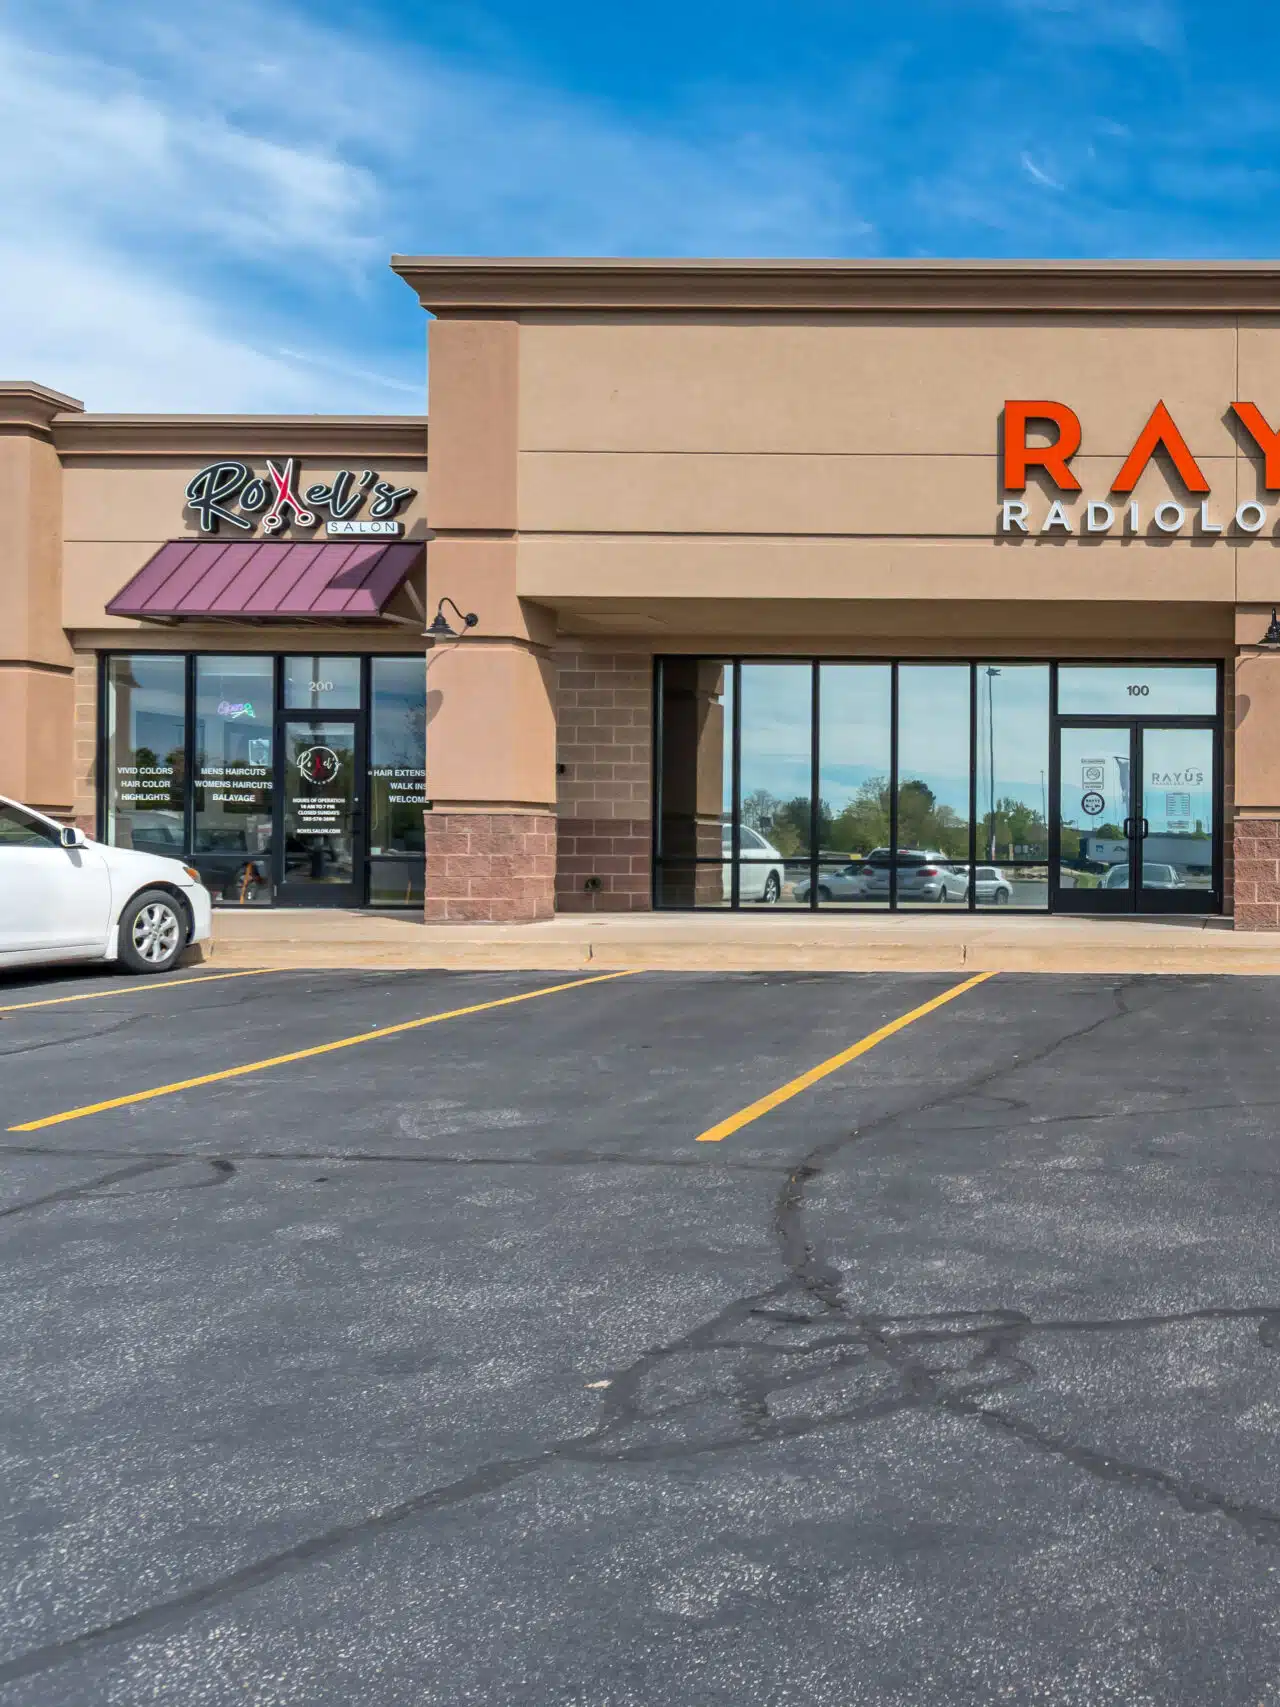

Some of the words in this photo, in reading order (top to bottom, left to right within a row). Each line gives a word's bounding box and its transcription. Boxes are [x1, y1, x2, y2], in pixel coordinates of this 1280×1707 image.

[330, 522, 397, 533] SALON
[308, 680, 334, 692] 200
[1126, 684, 1150, 696] 100
[117, 767, 138, 775] VIVID
[139, 767, 174, 775] COLORS
[201, 767, 224, 775] MENS
[225, 767, 267, 776] HAIRCUTS
[373, 769, 393, 777] HAIR
[394, 769, 426, 777] EXTENS
[1151, 772, 1204, 782] RAYUS
[120, 780, 141, 788] HAIR
[142, 780, 171, 788] COLOR
[194, 780, 231, 788] WOMENS
[232, 781, 273, 789] HAIRCUTS
[390, 782, 414, 790] WALK
[121, 793, 171, 801] HIGHLIGHTS
[212, 793, 256, 802] BALAYAGE
